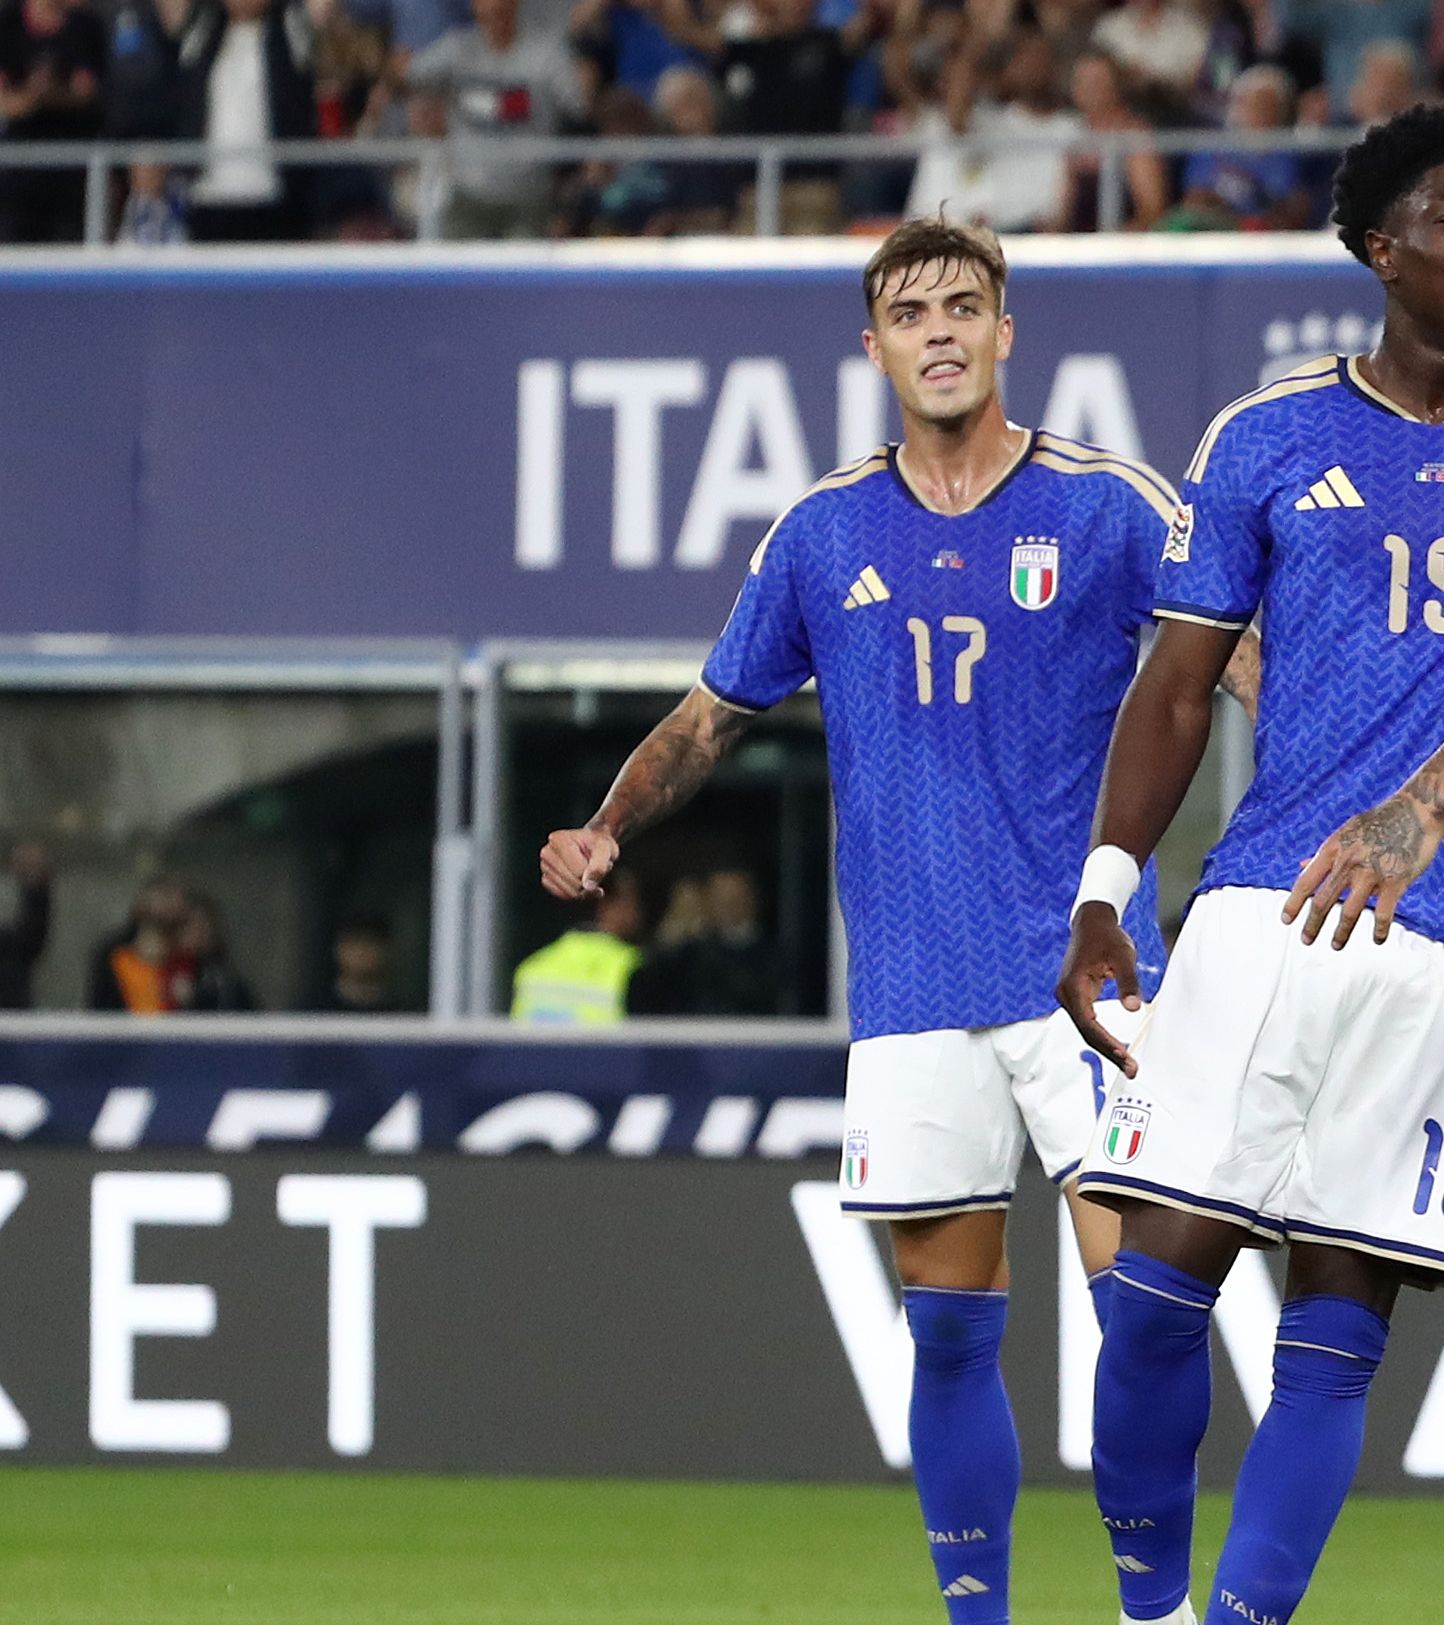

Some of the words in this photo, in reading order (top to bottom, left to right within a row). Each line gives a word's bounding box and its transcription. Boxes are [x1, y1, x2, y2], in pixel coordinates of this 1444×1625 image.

[514, 352, 1146, 570] ITAA
[1015, 551, 1055, 563] ITALIA
[906, 616, 987, 705] 17
[1114, 1110, 1145, 1124] ITALIA
[0, 1171, 428, 1457] ET
[927, 1528, 987, 1544] TALIA
